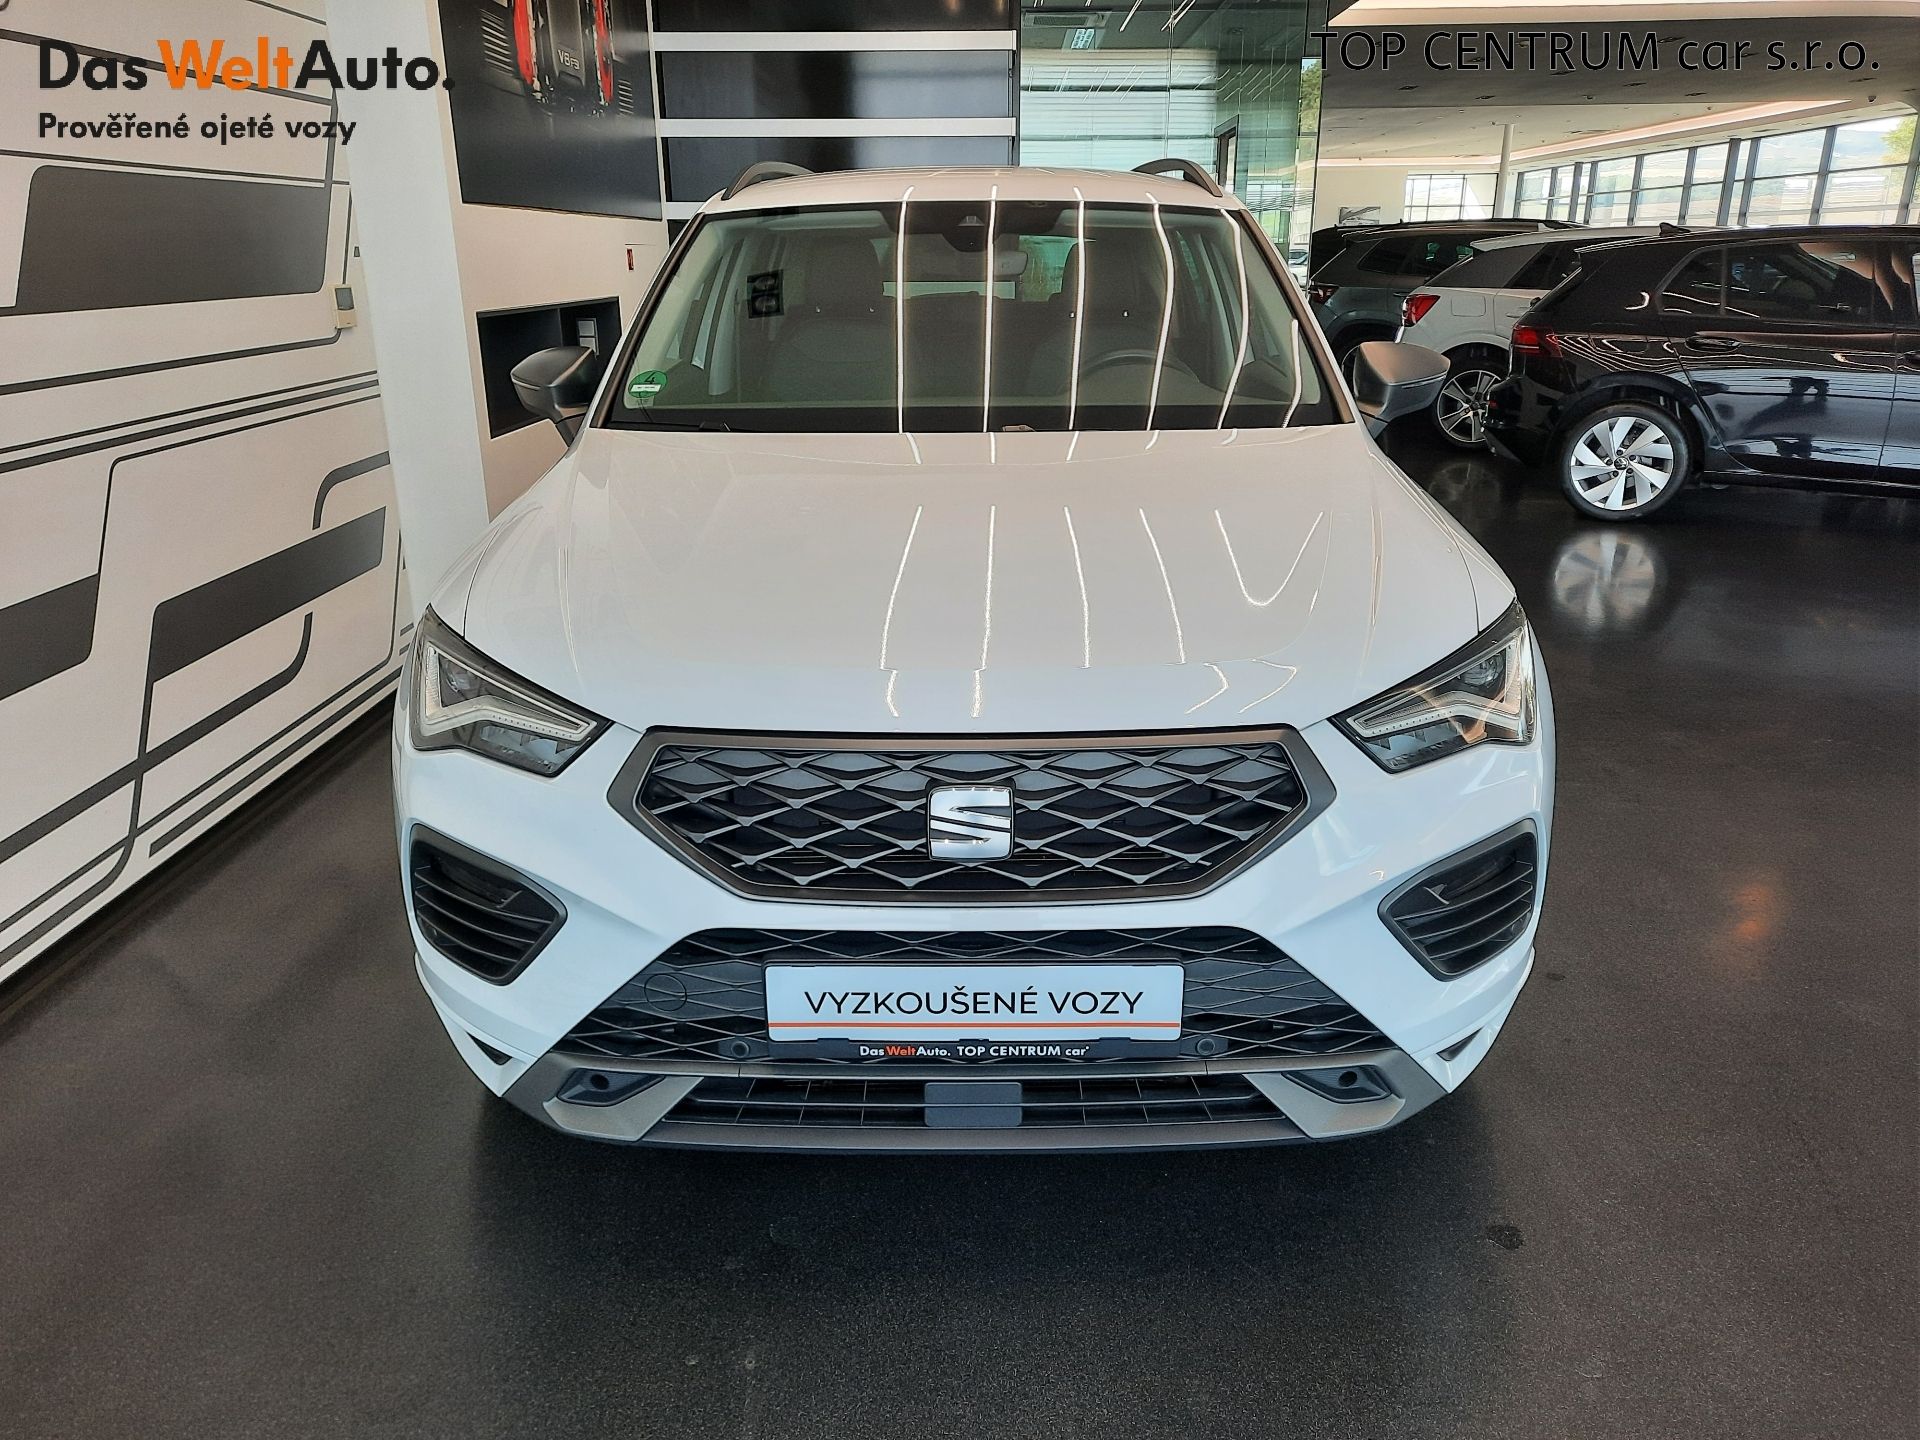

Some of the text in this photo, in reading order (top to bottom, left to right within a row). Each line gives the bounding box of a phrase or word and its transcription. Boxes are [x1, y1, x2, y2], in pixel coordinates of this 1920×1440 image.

[804, 985, 1144, 1016] VYZKOUŠENÉ VOZY
[957, 1045, 986, 1057] TOP
[989, 1045, 1061, 1057] CENTRUM
